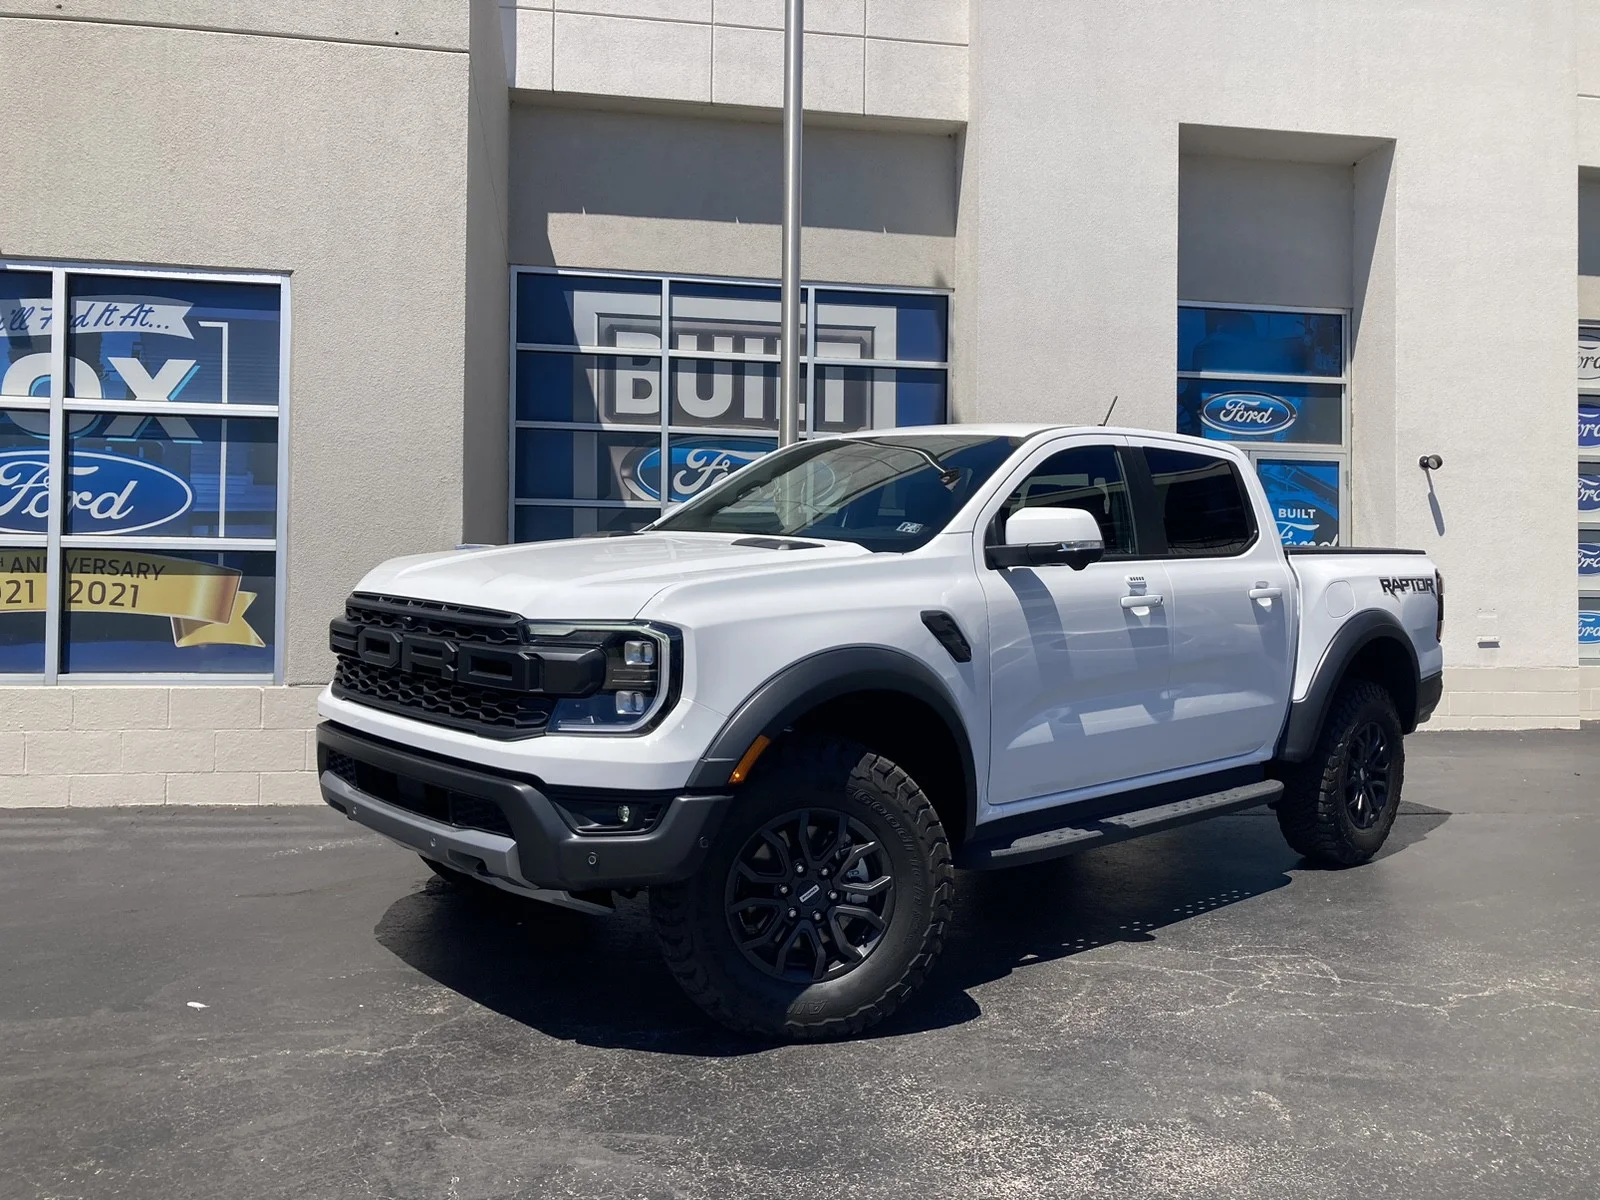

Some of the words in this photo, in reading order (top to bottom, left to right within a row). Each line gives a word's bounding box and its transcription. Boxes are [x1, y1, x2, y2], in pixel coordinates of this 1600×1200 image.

[94, 303, 119, 327] It
[1219, 399, 1274, 425] Ford
[1278, 508, 1316, 519] BUILT
[10, 556, 166, 581] ANVERSARY
[67, 579, 139, 608] 2021
[1378, 577, 1437, 602] RAPTOR
[330, 617, 533, 692] FORD
